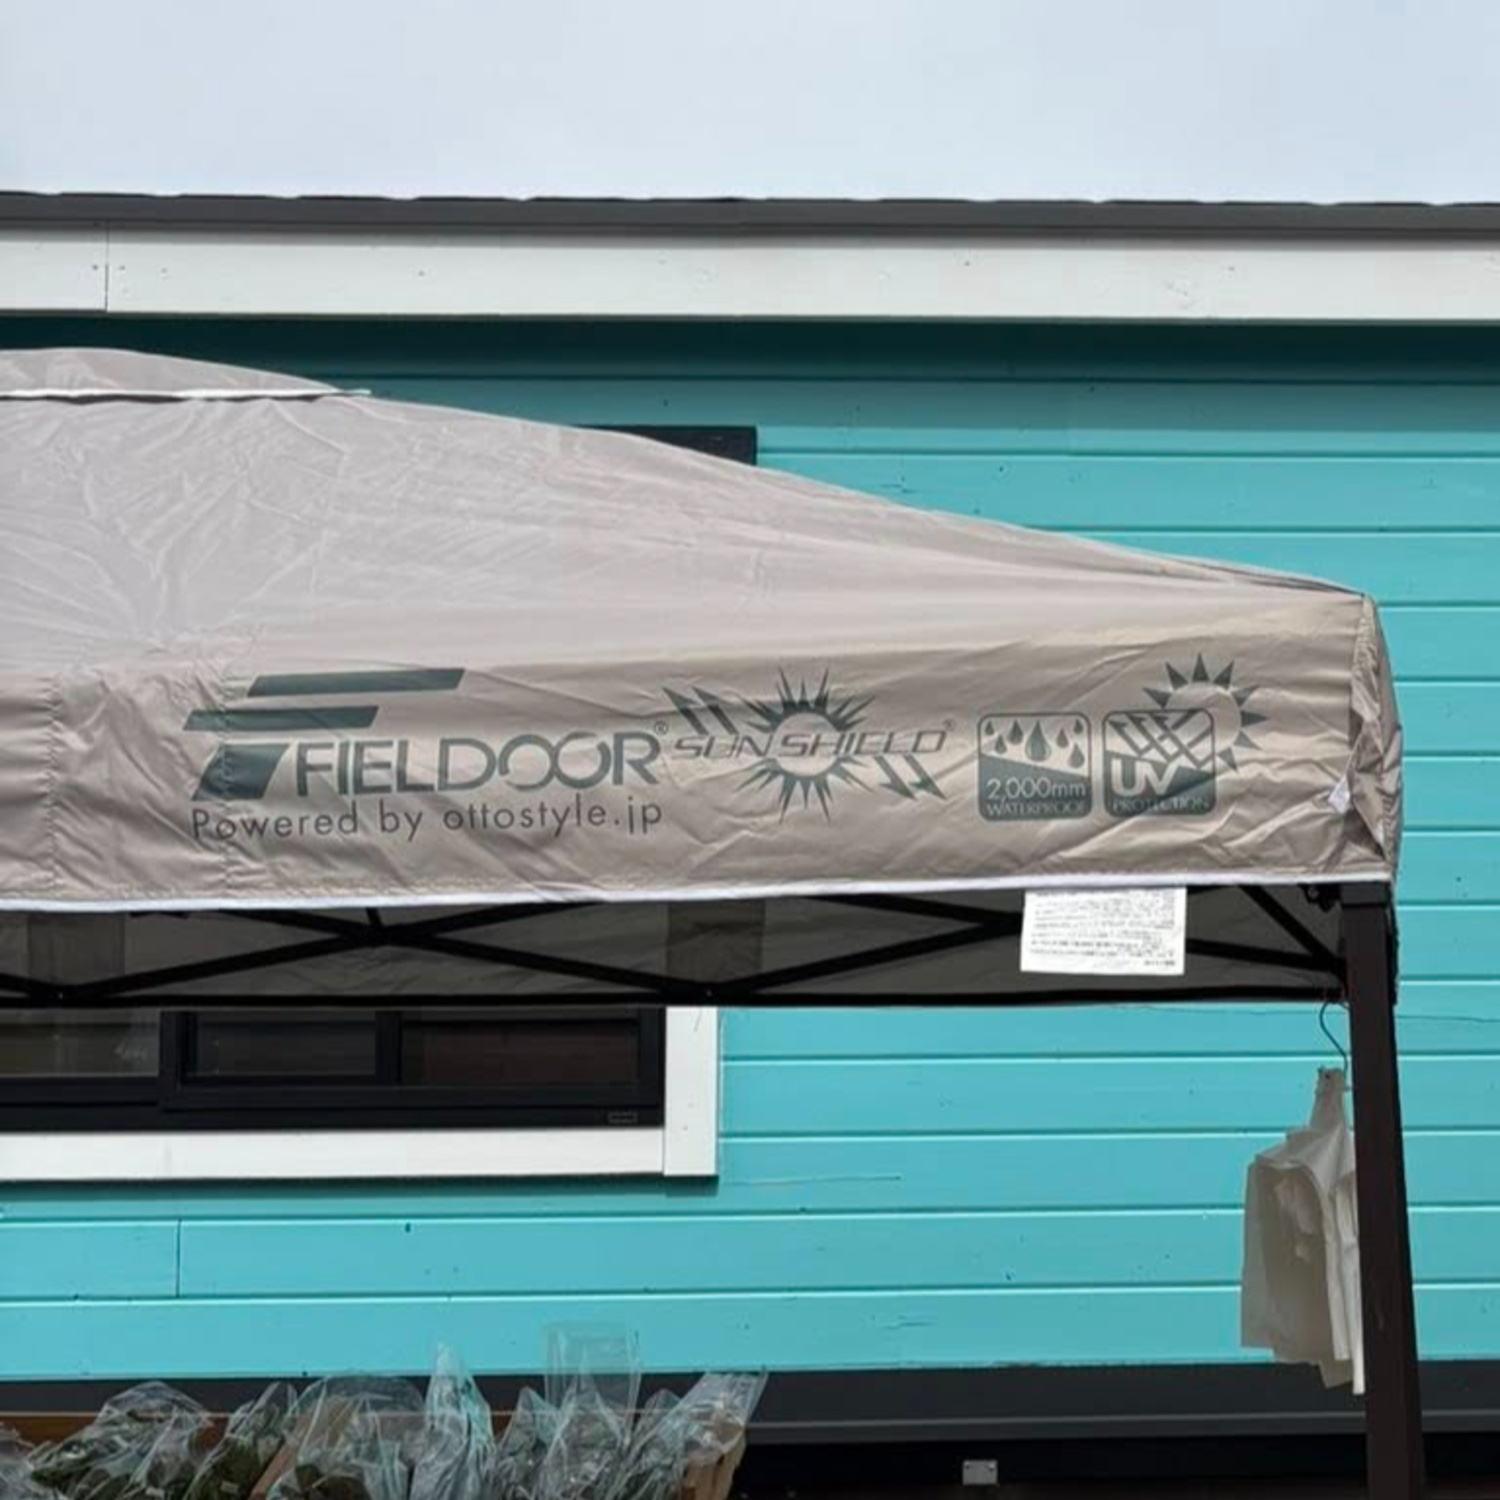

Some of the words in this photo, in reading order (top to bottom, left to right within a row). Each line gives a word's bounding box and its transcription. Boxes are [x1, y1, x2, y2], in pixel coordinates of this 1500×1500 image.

[1110, 757, 1180, 796] UV
[192, 800, 358, 841] Powered
[380, 799, 424, 843] by
[442, 793, 663, 838] ottostyle.jp
[985, 801, 1088, 816] WATERPROOF
[1112, 796, 1210, 813] PROTECTION
